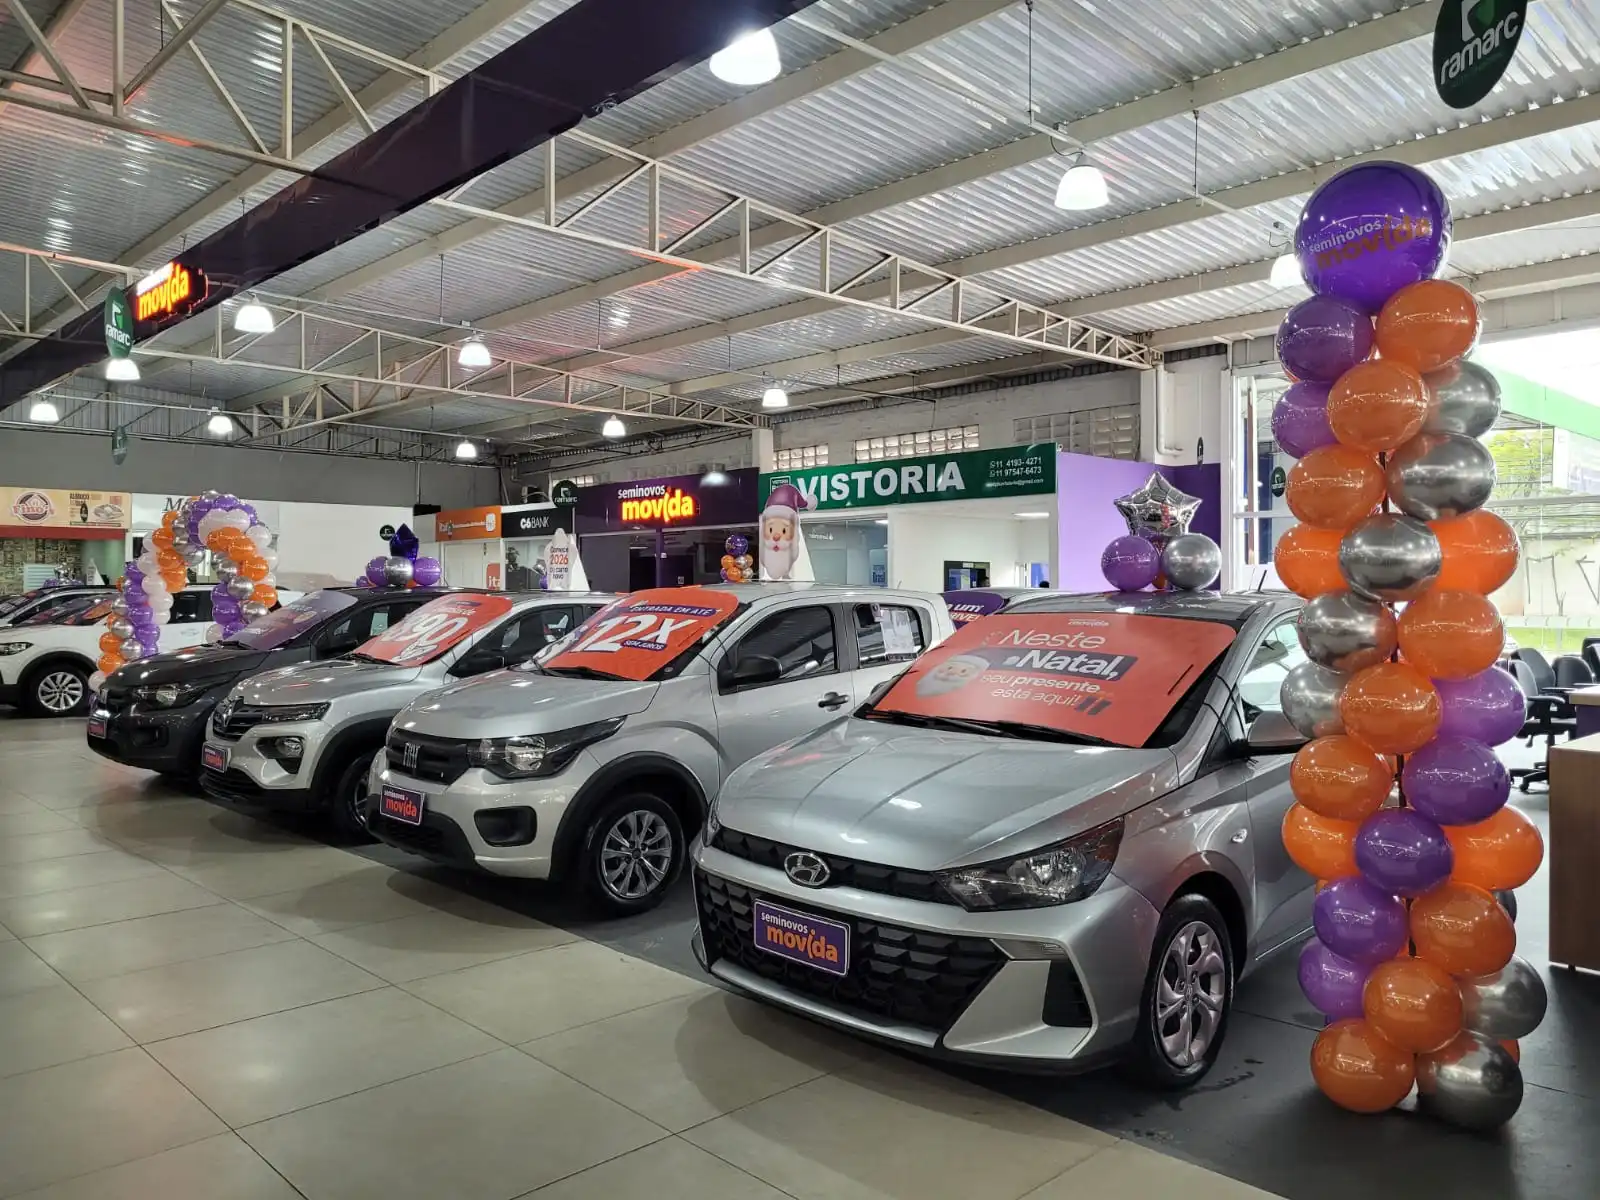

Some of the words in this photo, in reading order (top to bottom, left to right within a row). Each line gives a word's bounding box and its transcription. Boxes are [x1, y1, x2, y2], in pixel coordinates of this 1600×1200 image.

[1440, 11, 1519, 85] ramarc
[1308, 218, 1384, 254] seminovos
[1314, 214, 1432, 271] movida
[138, 262, 190, 321] movida
[105, 324, 131, 346] ramarc
[618, 484, 666, 500] seminovos
[796, 461, 966, 502] VISTORIA
[622, 486, 695, 523] movida
[549, 554, 569, 565] 2026
[568, 614, 698, 653] 12X
[998, 628, 1106, 649] Neste
[1015, 649, 1125, 681] Natal,
[982, 674, 1013, 683] seu
[1009, 675, 1100, 693] presente
[1032, 692, 1082, 706] aqui!
[385, 797, 418, 817] movida
[761, 911, 809, 934] seminovos
[766, 928, 839, 963] movida
